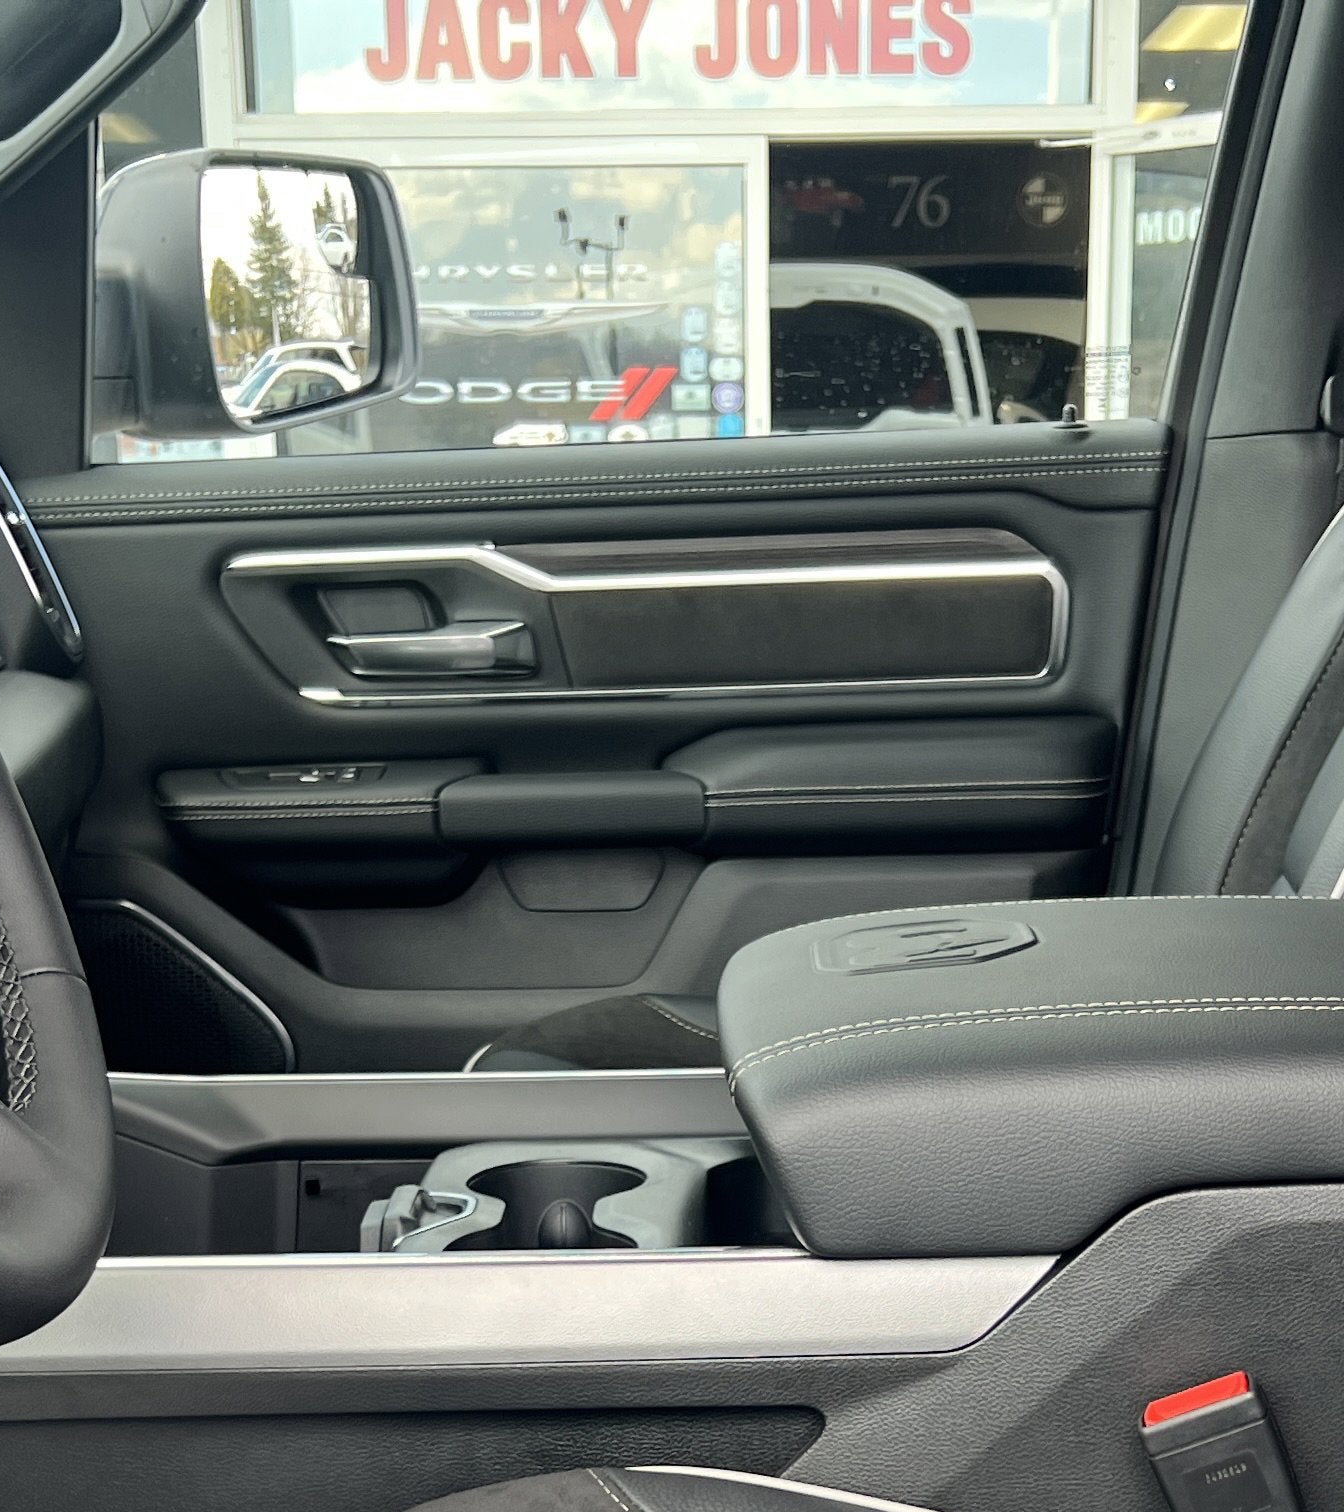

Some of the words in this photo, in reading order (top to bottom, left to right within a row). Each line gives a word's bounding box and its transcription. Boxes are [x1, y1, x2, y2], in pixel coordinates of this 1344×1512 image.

[362, 0, 654, 83] JACKY
[692, 0, 974, 83] JONES
[886, 174, 951, 230] 76
